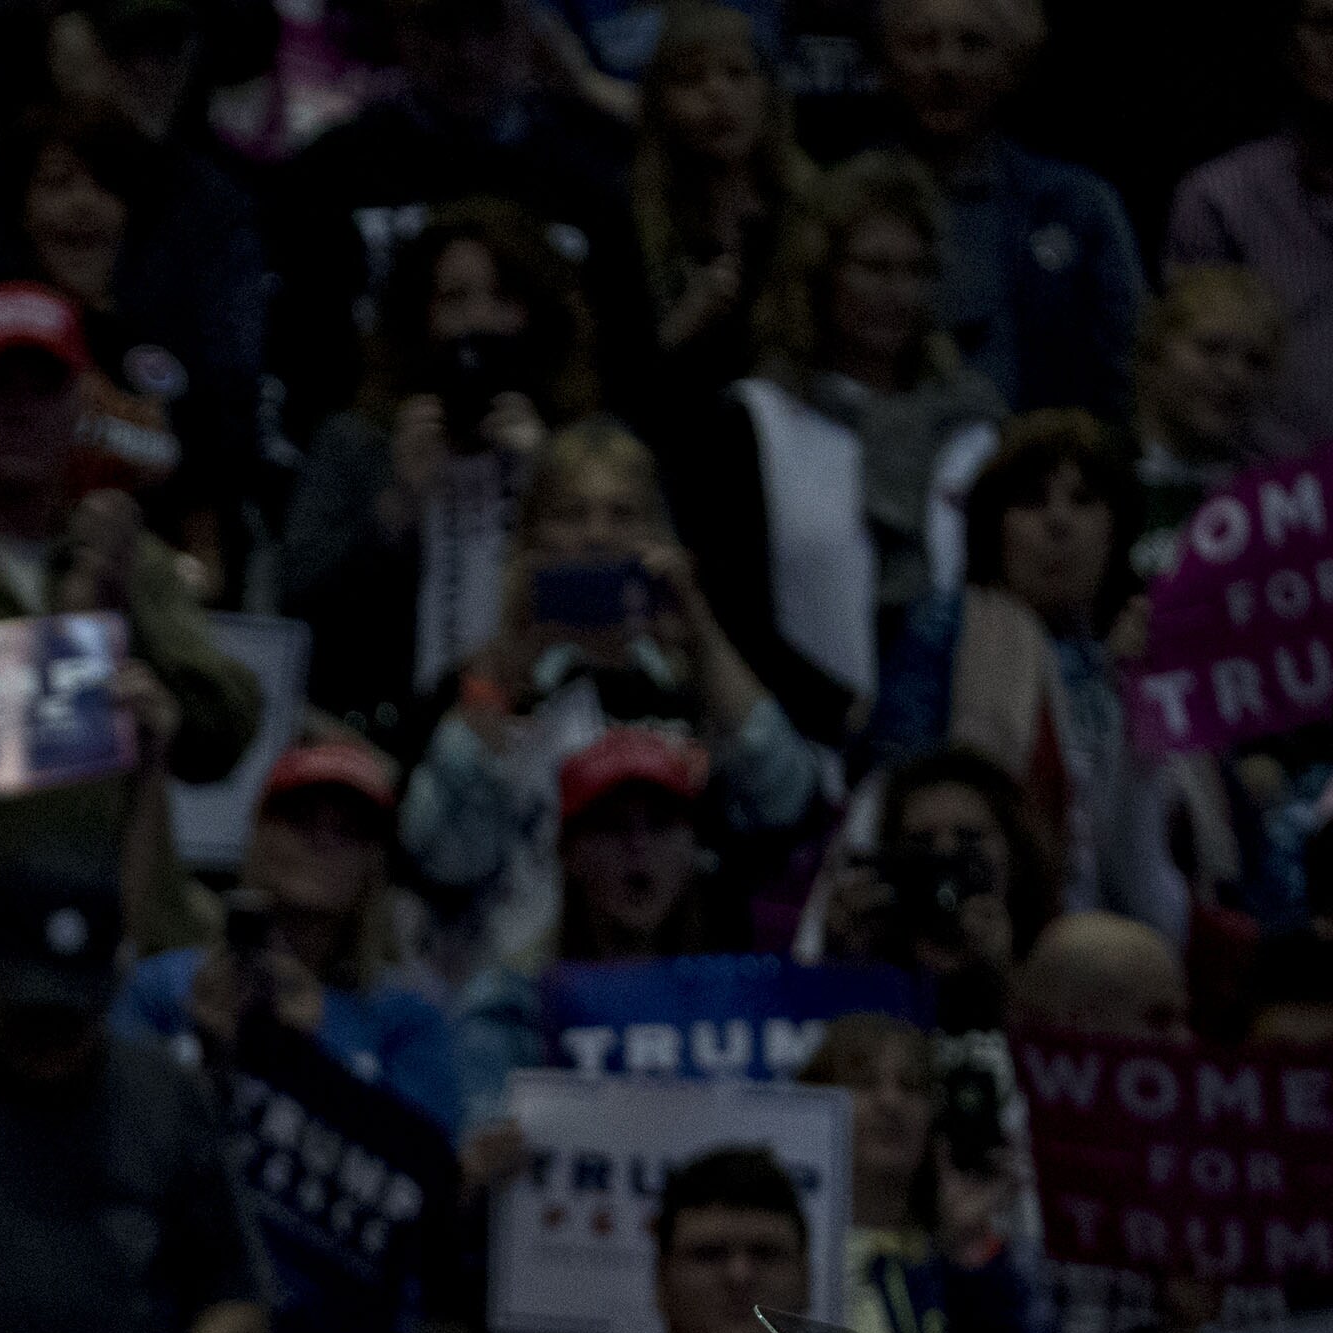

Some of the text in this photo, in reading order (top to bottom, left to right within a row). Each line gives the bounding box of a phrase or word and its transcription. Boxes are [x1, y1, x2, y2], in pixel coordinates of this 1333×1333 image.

[1141, 637, 1333, 735] TRU
[561, 1016, 831, 1080] TRUM
[1023, 1045, 1333, 1128] WOME
[1147, 1145, 1283, 1190] FOR
[1057, 1196, 1330, 1276] TRUM
